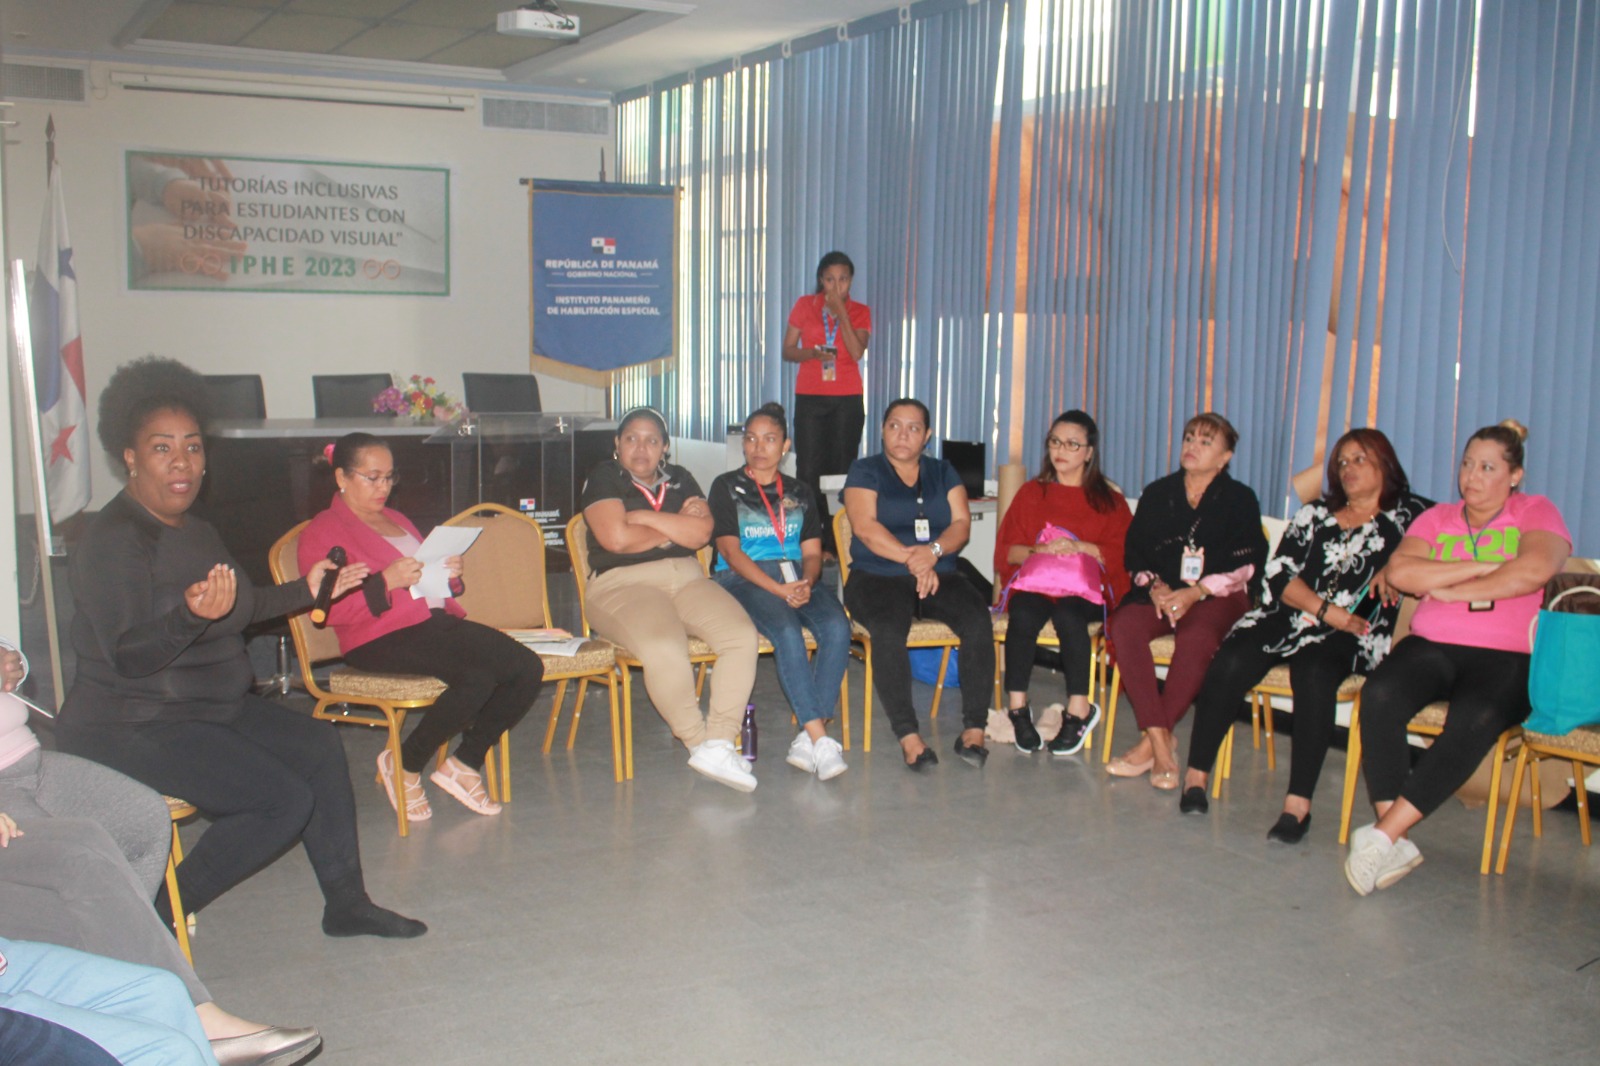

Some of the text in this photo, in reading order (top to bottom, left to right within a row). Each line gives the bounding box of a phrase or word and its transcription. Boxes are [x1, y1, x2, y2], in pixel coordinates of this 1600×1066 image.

[294, 180, 399, 200] INCLUSIVAS
[180, 199, 405, 224] PARA ESTUDIANTES CON
[183, 225, 325, 244] DISCAPACIDAD
[230, 255, 356, 277] IPHE 2023
[545, 258, 659, 269] REPÚBLICA DE PANAMÁ
[555, 294, 651, 305] INSTITUTO PANAMEÑO
[547, 305, 661, 316] DE HABILITACIÓN ESPECIAL
